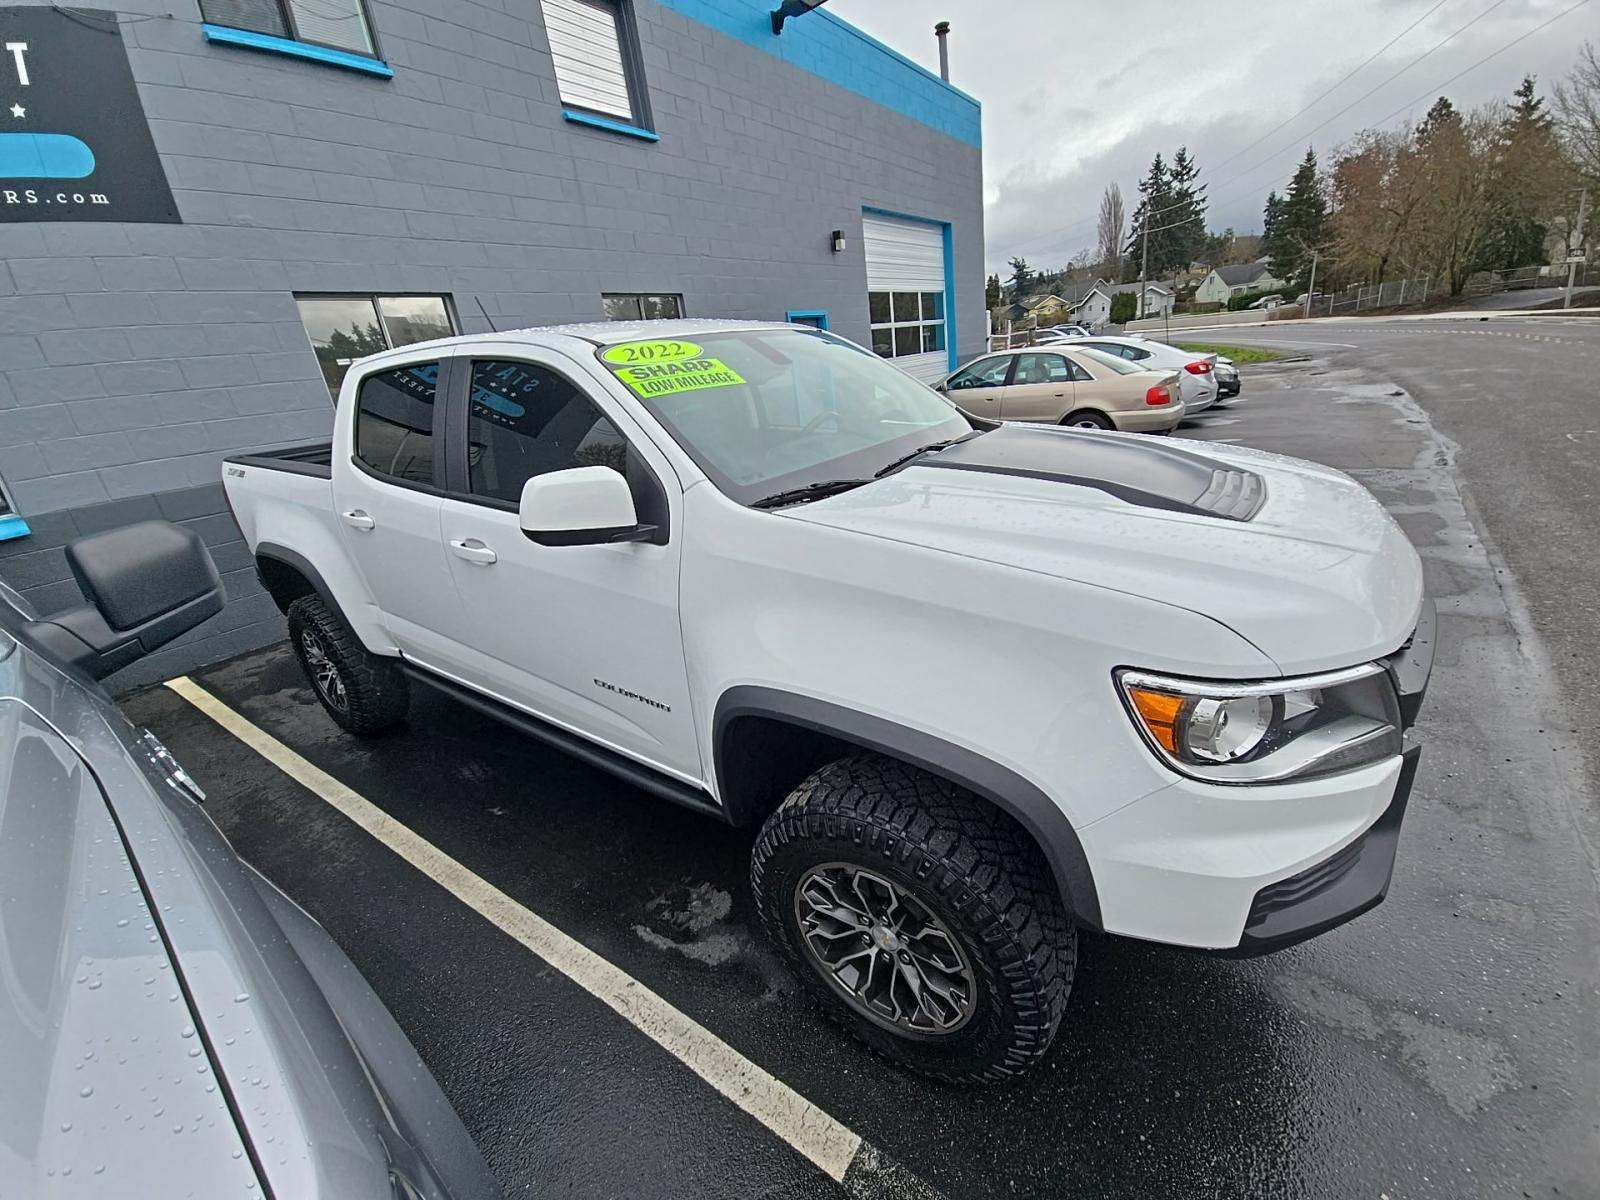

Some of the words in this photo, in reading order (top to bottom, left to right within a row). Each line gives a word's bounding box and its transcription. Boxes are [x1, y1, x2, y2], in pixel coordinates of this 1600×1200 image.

[3, 189, 110, 204] RS.com
[622, 342, 686, 362] 2022
[628, 359, 714, 380] SHARP
[639, 377, 675, 394] LOW
[674, 370, 736, 390] MILEAGE
[593, 678, 672, 713] COLORADO
